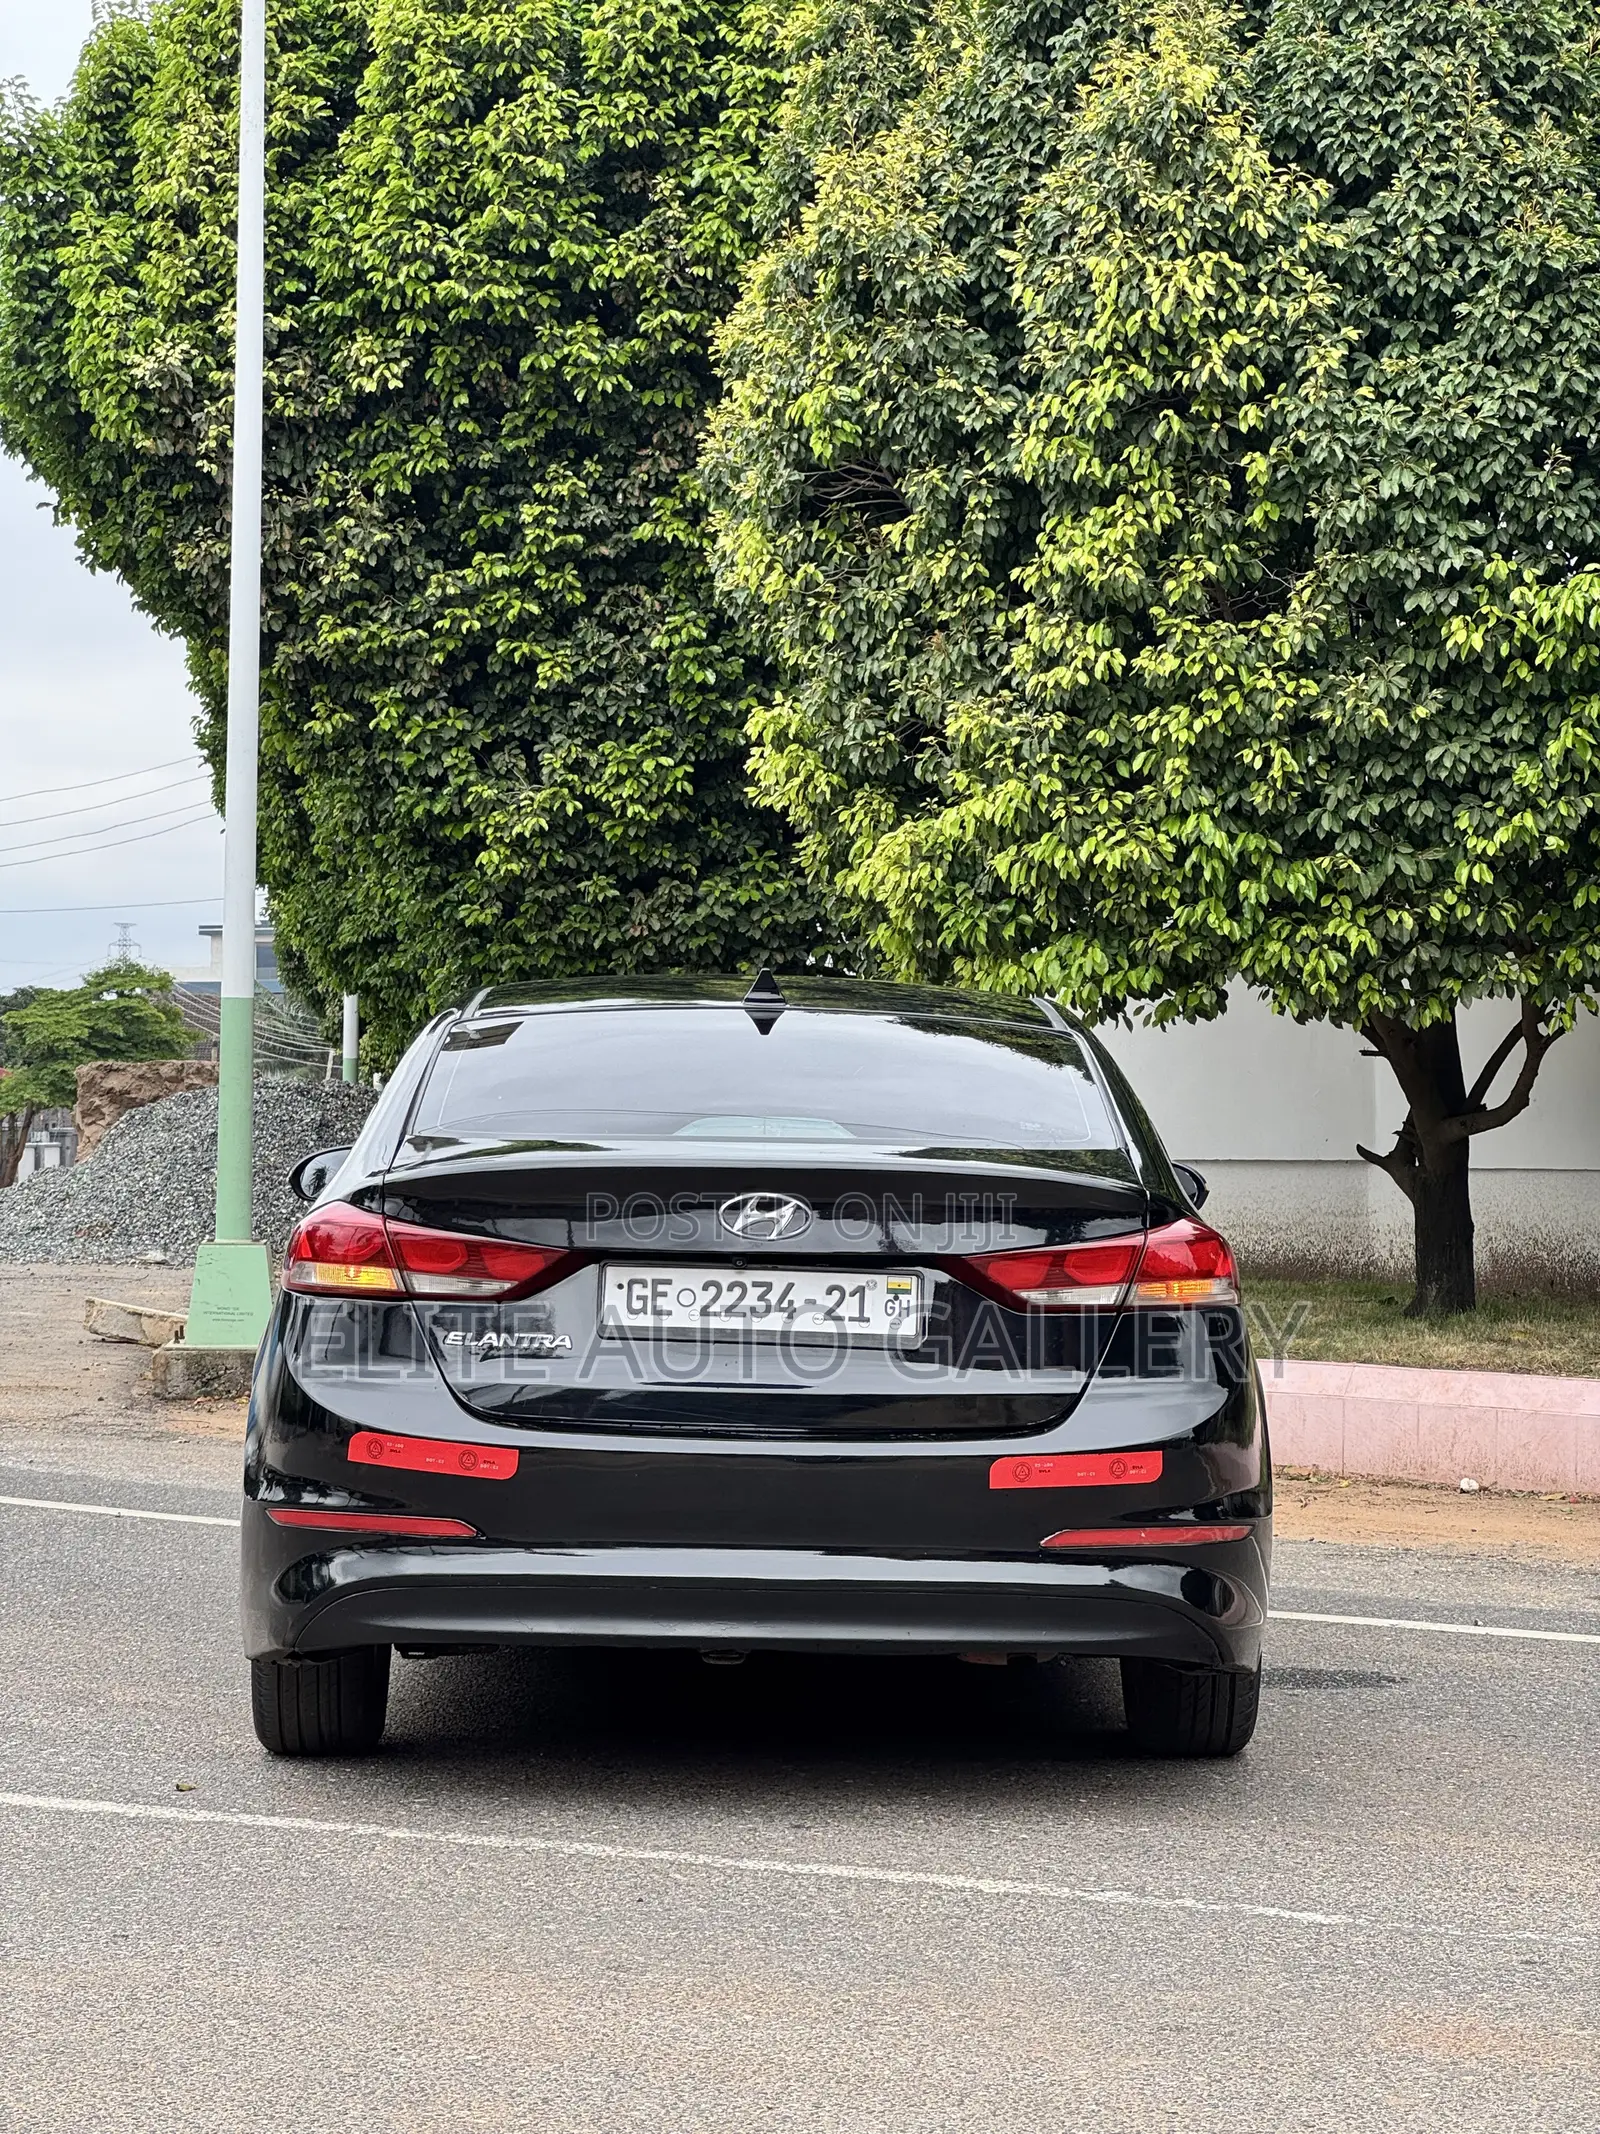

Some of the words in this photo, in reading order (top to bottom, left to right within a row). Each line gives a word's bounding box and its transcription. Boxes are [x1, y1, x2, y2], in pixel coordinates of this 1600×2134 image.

[626, 1278, 673, 1317] GE
[884, 1298, 911, 1318] GH
[443, 1331, 573, 1350] ELANTRA
